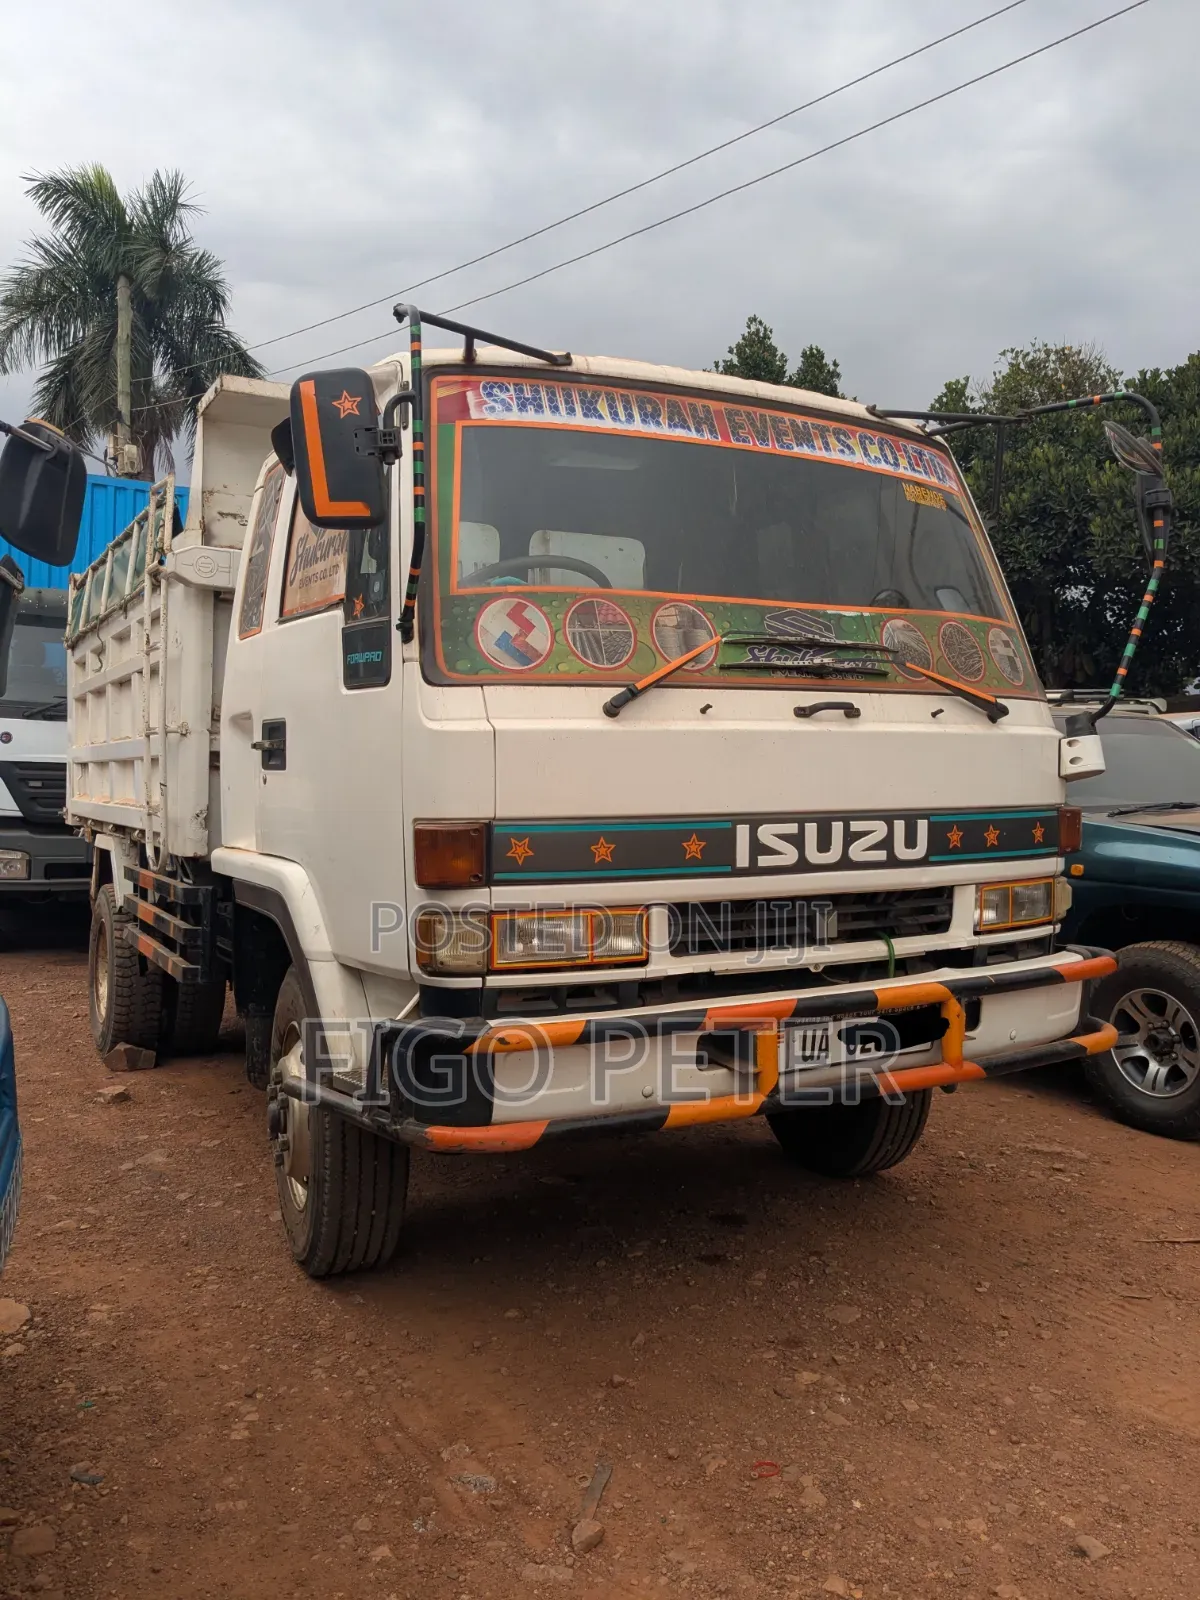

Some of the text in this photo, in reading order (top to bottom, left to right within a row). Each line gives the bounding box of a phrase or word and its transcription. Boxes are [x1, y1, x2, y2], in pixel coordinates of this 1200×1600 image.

[480, 381, 722, 441] SHUKURAH
[722, 407, 857, 461] EVENTS
[299, 571, 319, 589] EVENTS
[736, 819, 928, 868] ISUZU
